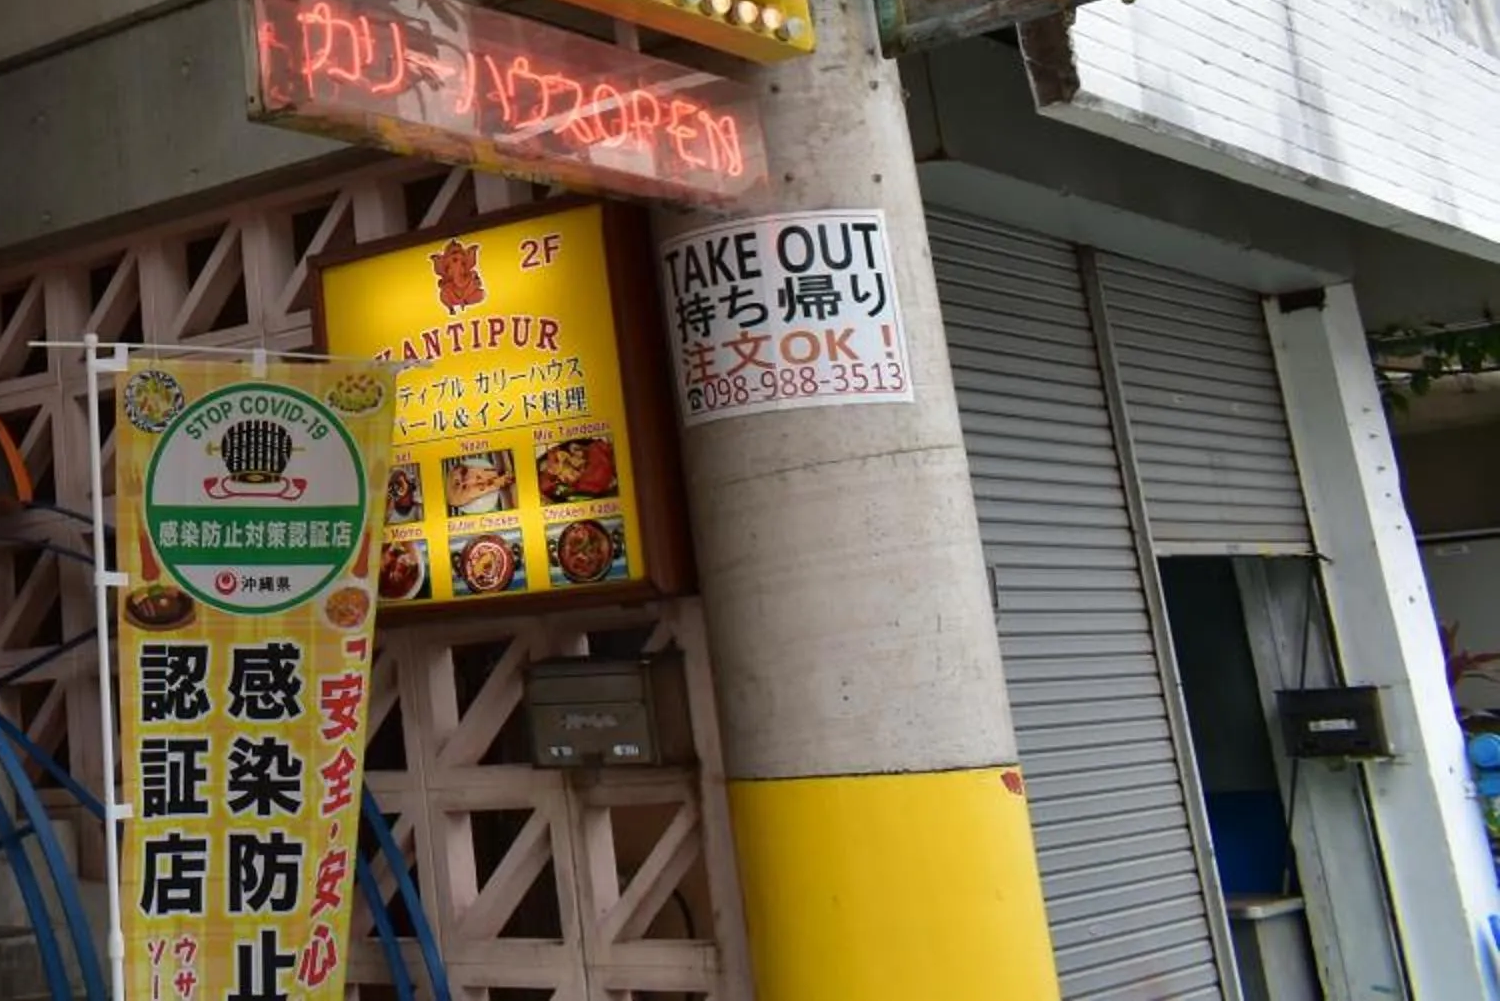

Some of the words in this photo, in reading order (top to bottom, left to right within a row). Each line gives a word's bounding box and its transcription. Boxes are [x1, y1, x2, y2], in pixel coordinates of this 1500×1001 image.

[519, 234, 561, 270] 2F
[663, 231, 763, 298] TAKE
[776, 222, 879, 274] OUT
[675, 272, 887, 344] 持ち帰り
[702, 361, 905, 412] 098-988-3513
[185, 401, 234, 441] STOP
[239, 395, 330, 441] COVID-19
[159, 519, 353, 549] 感染防止対策認証店
[240, 575, 292, 593] 沖縄県
[139, 644, 211, 916] 認証店
[227, 642, 303, 1001] 感染防止
[173, 937, 197, 998] ウサ
